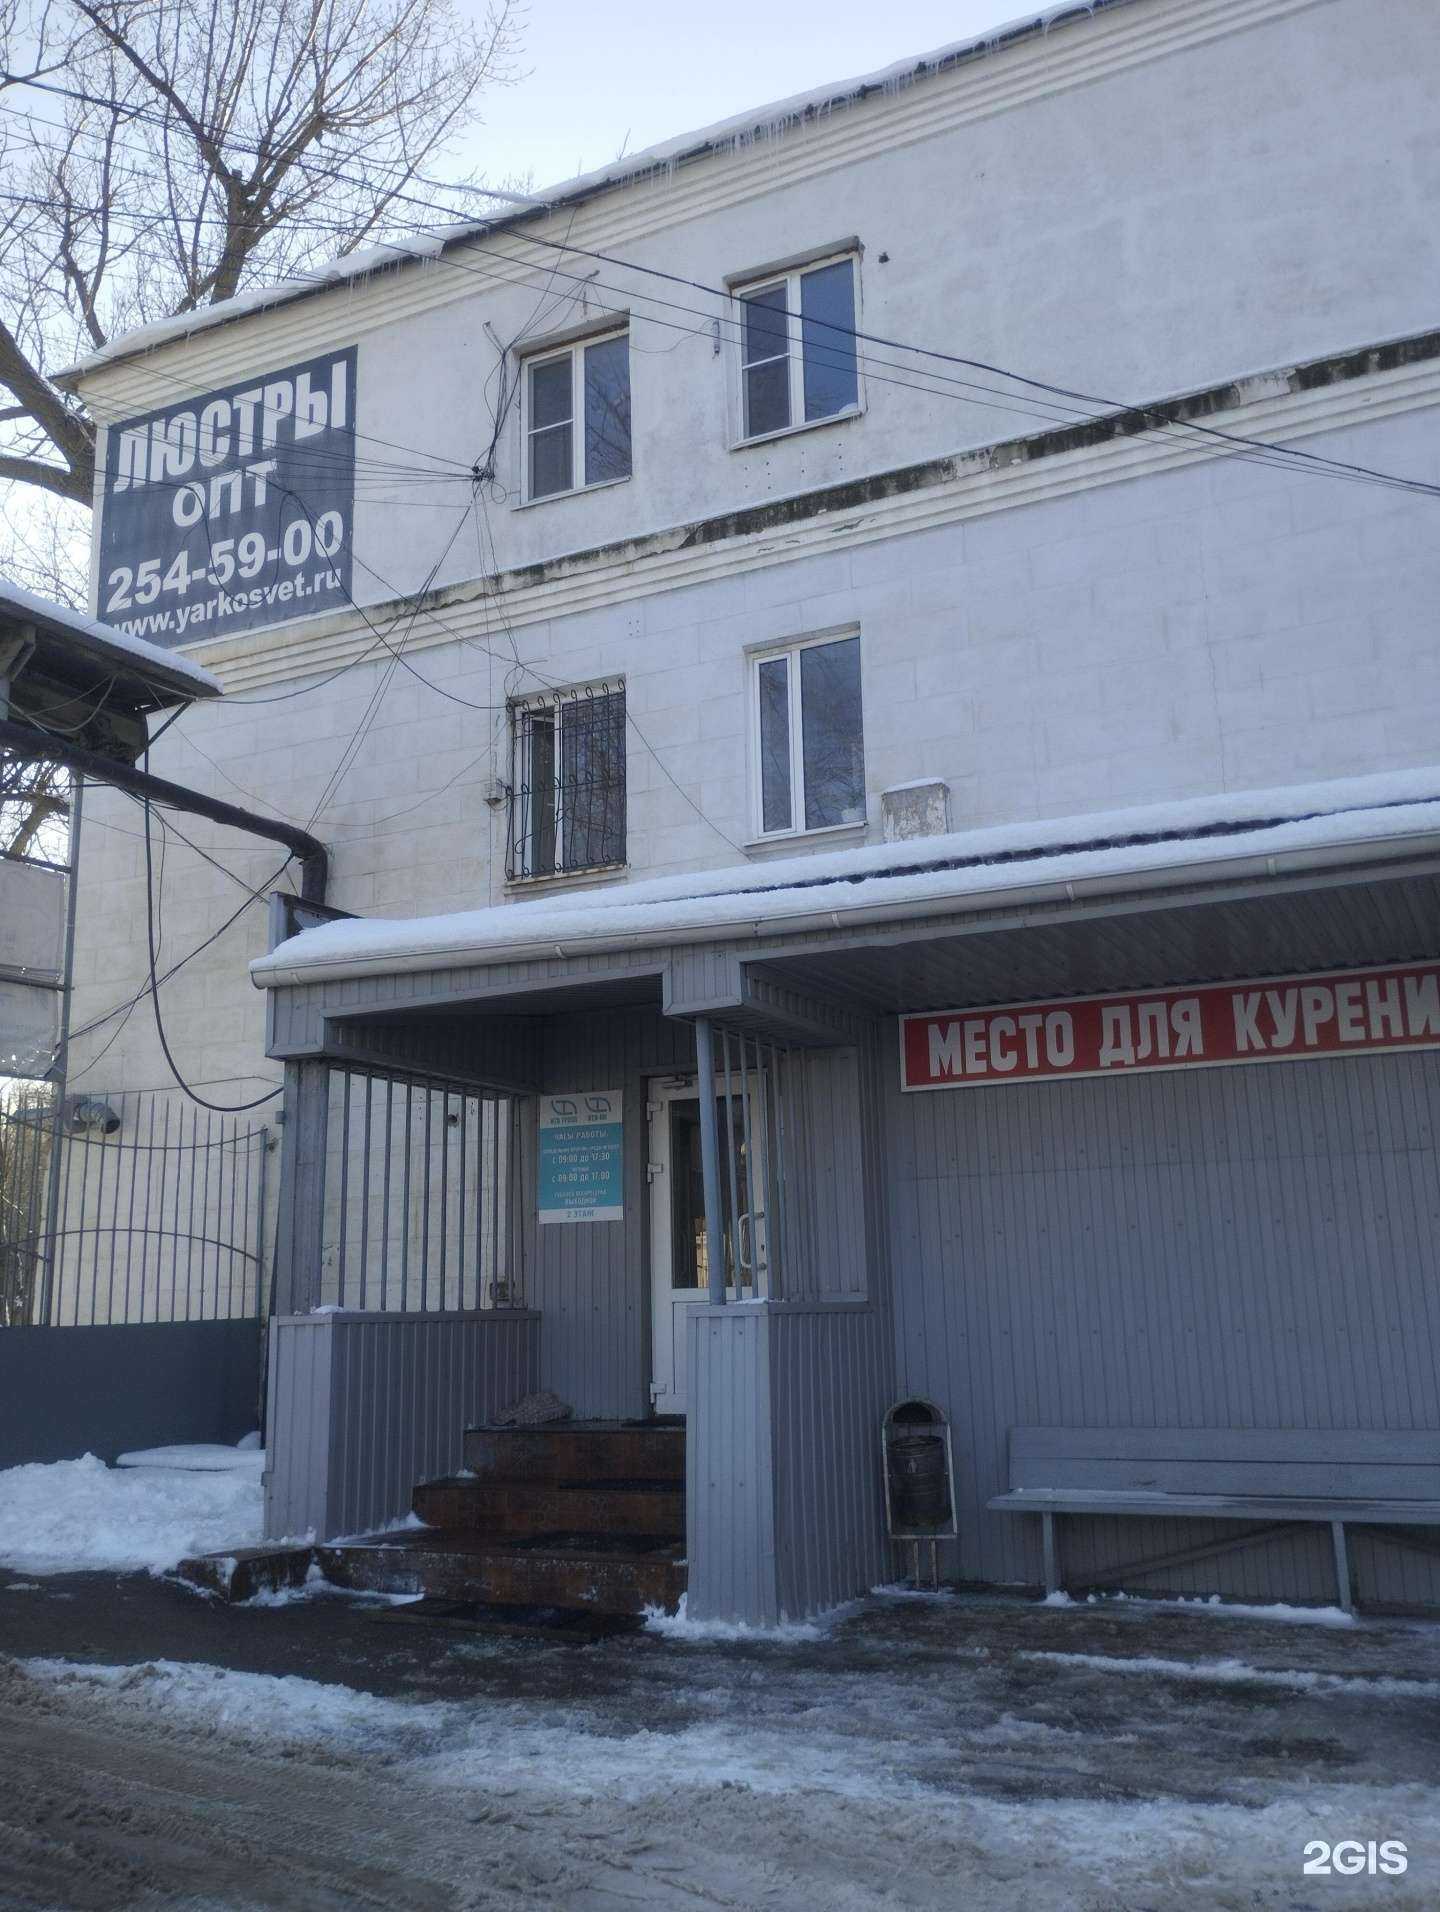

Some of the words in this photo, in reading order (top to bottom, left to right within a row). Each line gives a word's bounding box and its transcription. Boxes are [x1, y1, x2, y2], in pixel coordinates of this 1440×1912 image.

[112, 360, 347, 494] ЛЮСТРЫ
[172, 459, 277, 528] ОПТ
[106, 511, 344, 612] 254-59-00
[112, 566, 342, 637] www.yarkosvet.ru
[927, 1011, 1075, 1078] МЕСТО
[1099, 998, 1205, 1067] ДЛЯ
[591, 1152, 610, 1161] 17:30
